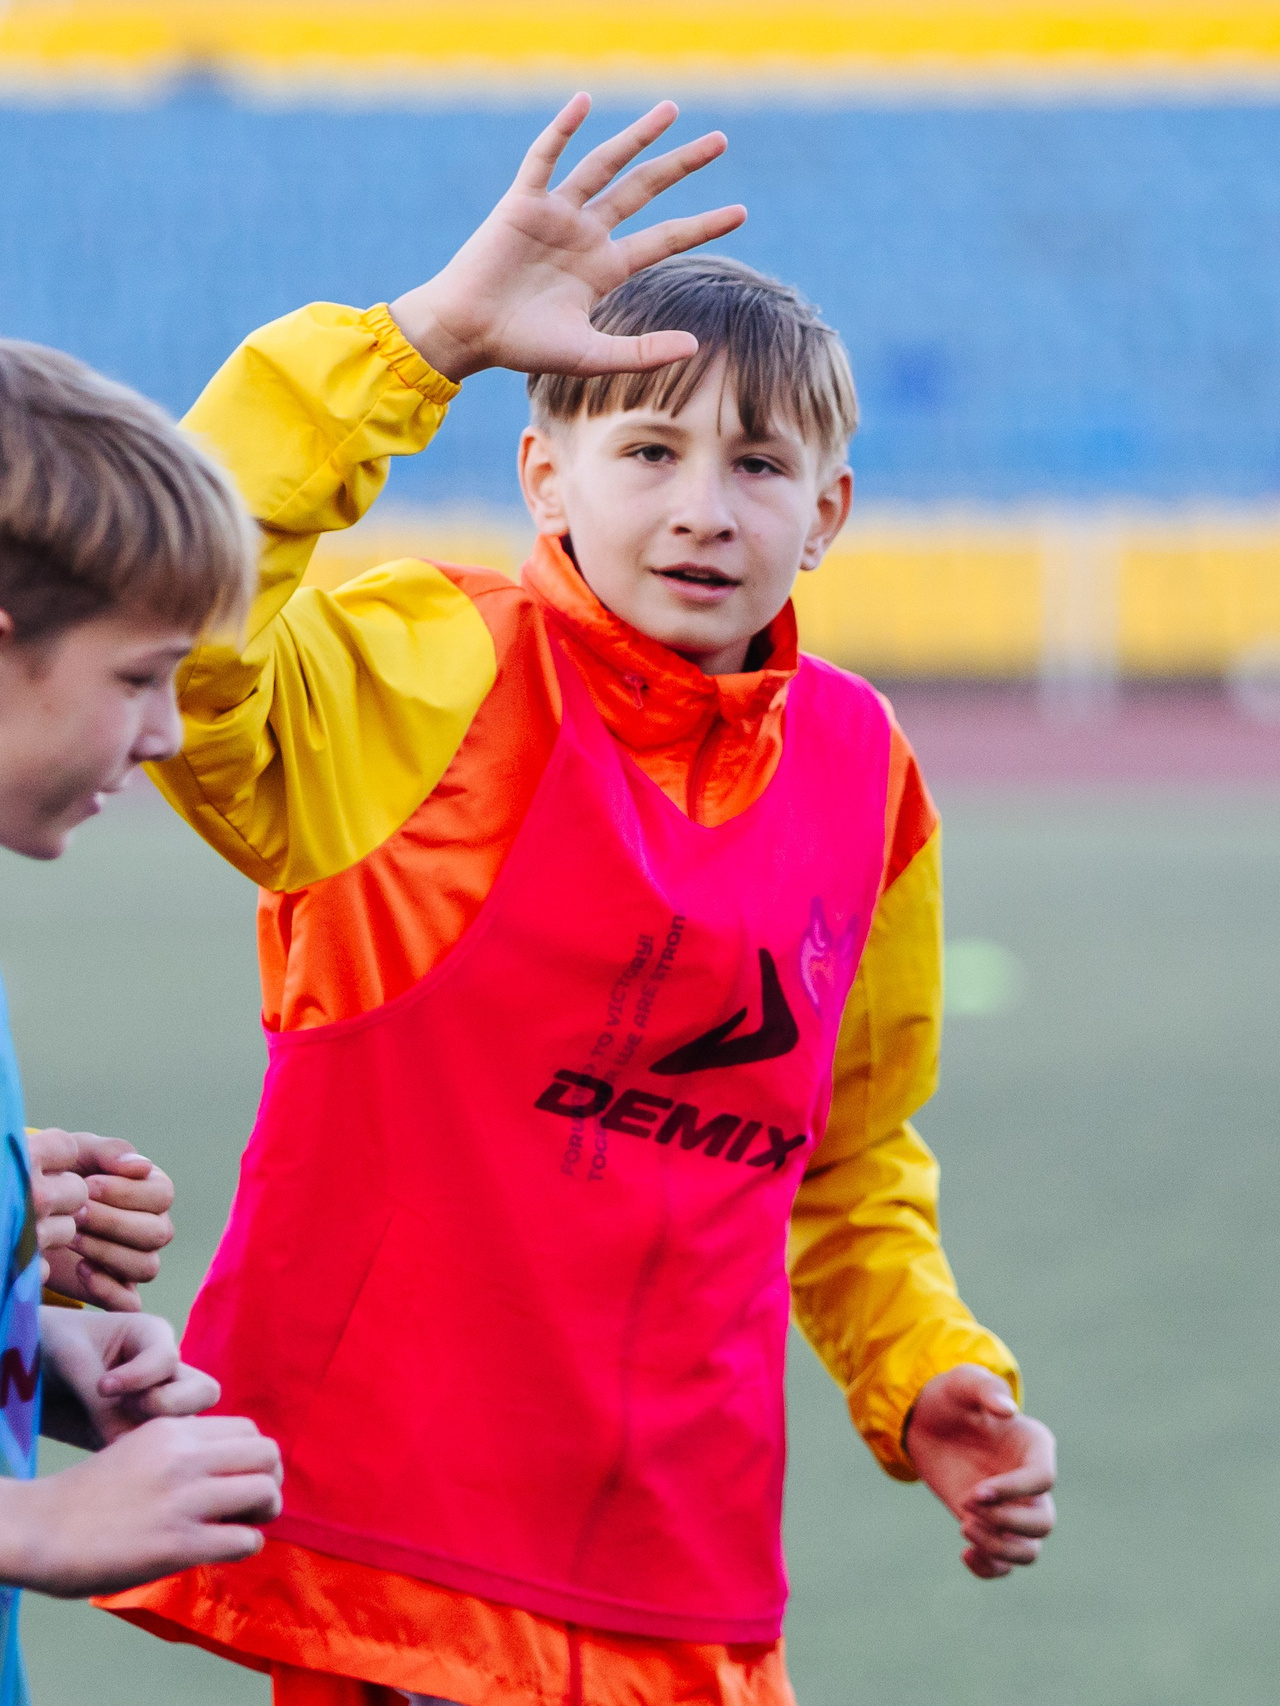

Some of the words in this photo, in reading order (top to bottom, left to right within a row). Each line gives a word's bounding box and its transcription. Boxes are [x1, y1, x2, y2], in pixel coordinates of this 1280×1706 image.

[634, 983, 660, 1029] ARE
[590, 1031, 614, 1056] TO
[533, 1068, 807, 1171] DEMIX
